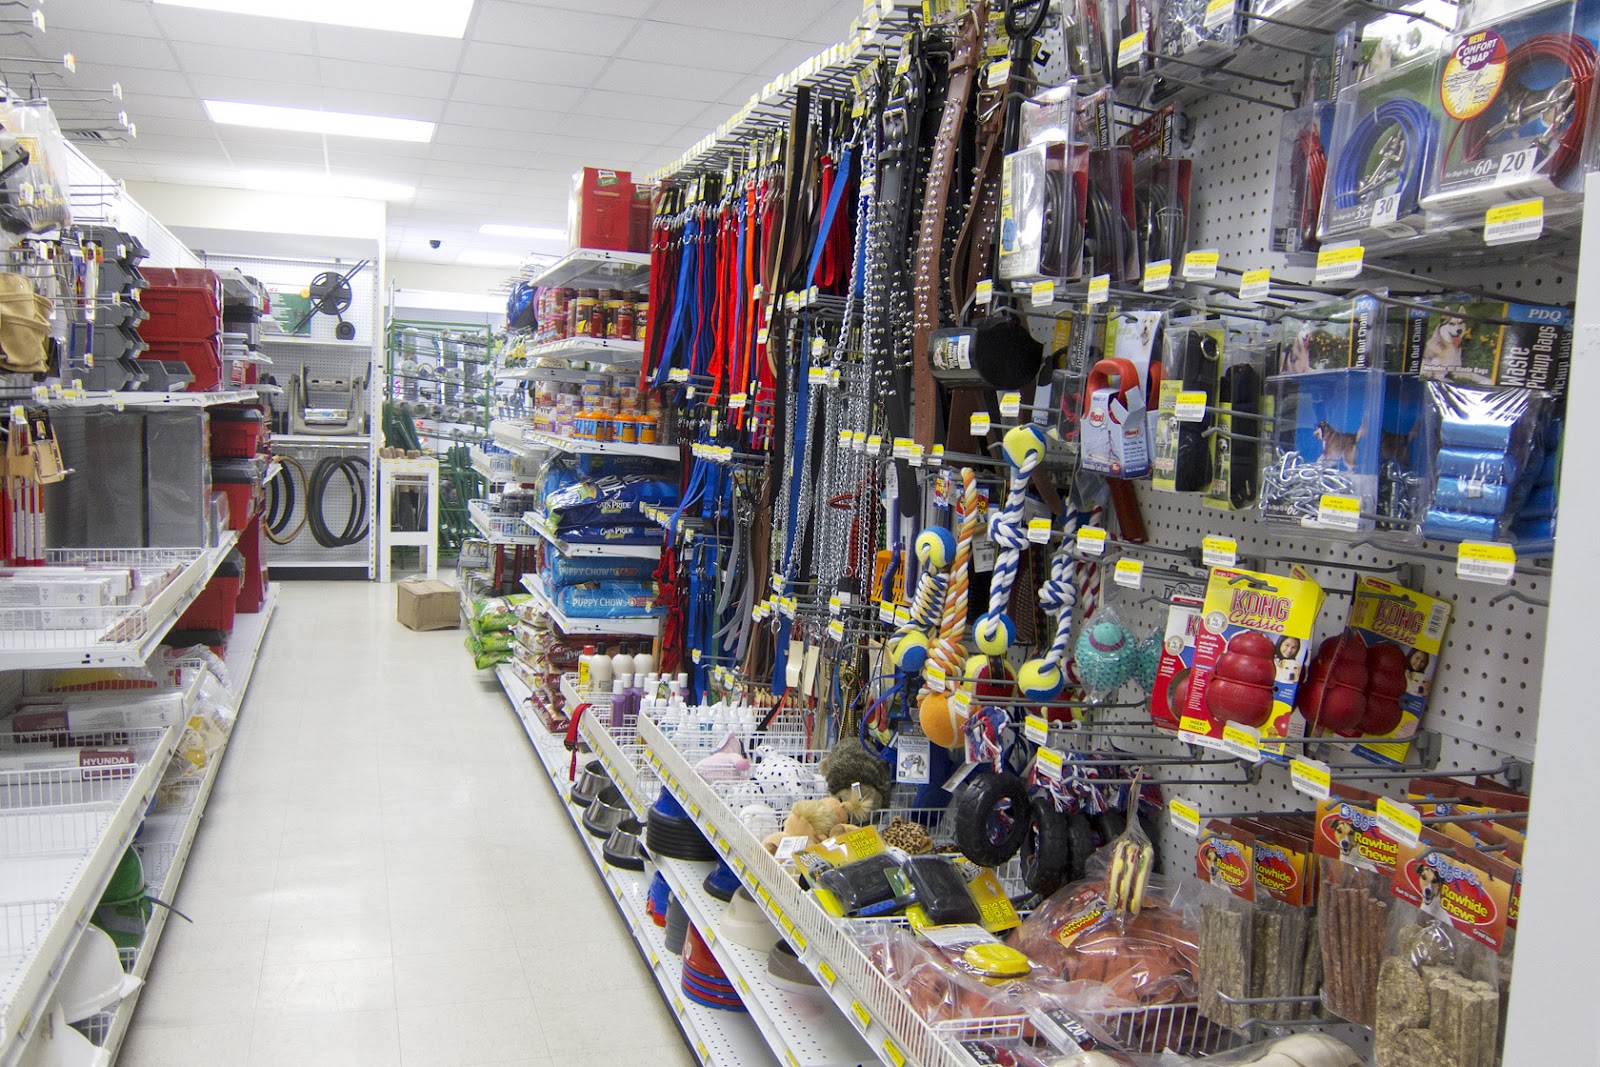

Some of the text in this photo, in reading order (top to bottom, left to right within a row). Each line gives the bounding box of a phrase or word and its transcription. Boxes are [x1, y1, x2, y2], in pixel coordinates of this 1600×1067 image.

[1456, 38, 1498, 60] COMFORT
[1462, 51, 1489, 69] SNAP
[1474, 159, 1492, 176] 60
[1503, 152, 1526, 173] 20
[1354, 204, 1369, 220] 35
[1377, 196, 1394, 216] 30
[1356, 301, 1373, 311] PDQ
[1528, 309, 1562, 322] PDQ
[1358, 312, 1368, 337] Chain
[1412, 318, 1422, 343] Chain
[1357, 337, 1367, 354] Out
[1411, 344, 1421, 359] Out
[1526, 325, 1558, 390] Pickup Bags
[1500, 346, 1530, 387] Waste
[611, 501, 631, 509] PRIDE
[615, 526, 634, 534] PRIDE
[560, 567, 609, 576] PUPPY CHOW
[572, 598, 623, 607] PUPPY CHOW
[1231, 588, 1291, 622] KONG
[1229, 609, 1285, 633] Classic
[1374, 600, 1425, 635] KONG
[1371, 619, 1417, 645] Classic
[1189, 719, 1206, 727] INSERT
[899, 739, 912, 748] Quick
[82, 756, 129, 766] HYUNDAI
[846, 830, 868, 842] Large
[851, 836, 877, 850] Slicker
[1354, 832, 1399, 854] Rawhid
[856, 846, 877, 859] Brush
[1358, 845, 1396, 865] Chews
[1216, 859, 1245, 878] Rawhide
[1426, 852, 1476, 886] Digger's
[1220, 870, 1241, 886] Chews
[1256, 874, 1286, 891] Chews
[999, 900, 1013, 918] Large
[1441, 884, 1488, 917] Rawhide
[980, 904, 994, 923] Brush
[989, 902, 1007, 924] Slicker
[1441, 897, 1476, 925] Chews
[1471, 928, 1485, 938] Great
[1062, 1020, 1086, 1037] 120
[974, 1050, 990, 1060] 60
